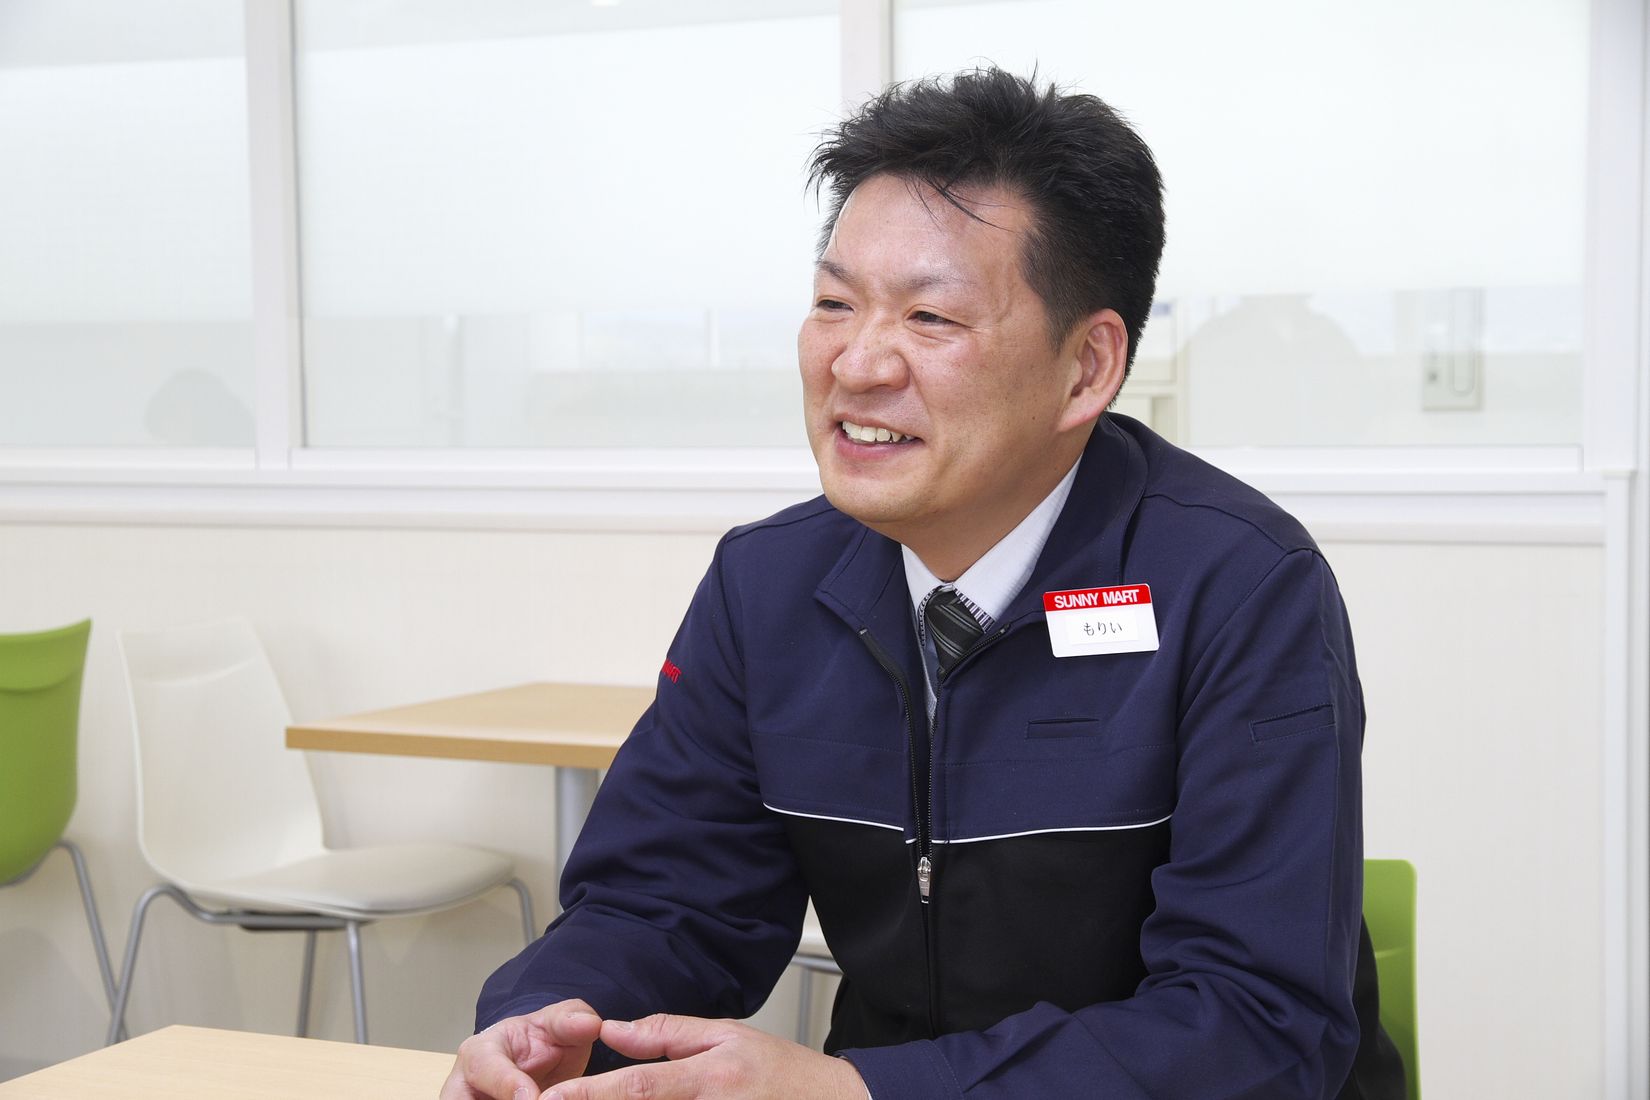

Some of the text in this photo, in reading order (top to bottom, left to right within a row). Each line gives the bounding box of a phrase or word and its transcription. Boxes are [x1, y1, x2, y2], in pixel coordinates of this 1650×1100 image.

[1054, 589, 1140, 608] SUNNY MART
[1083, 621, 1123, 636] もりい
